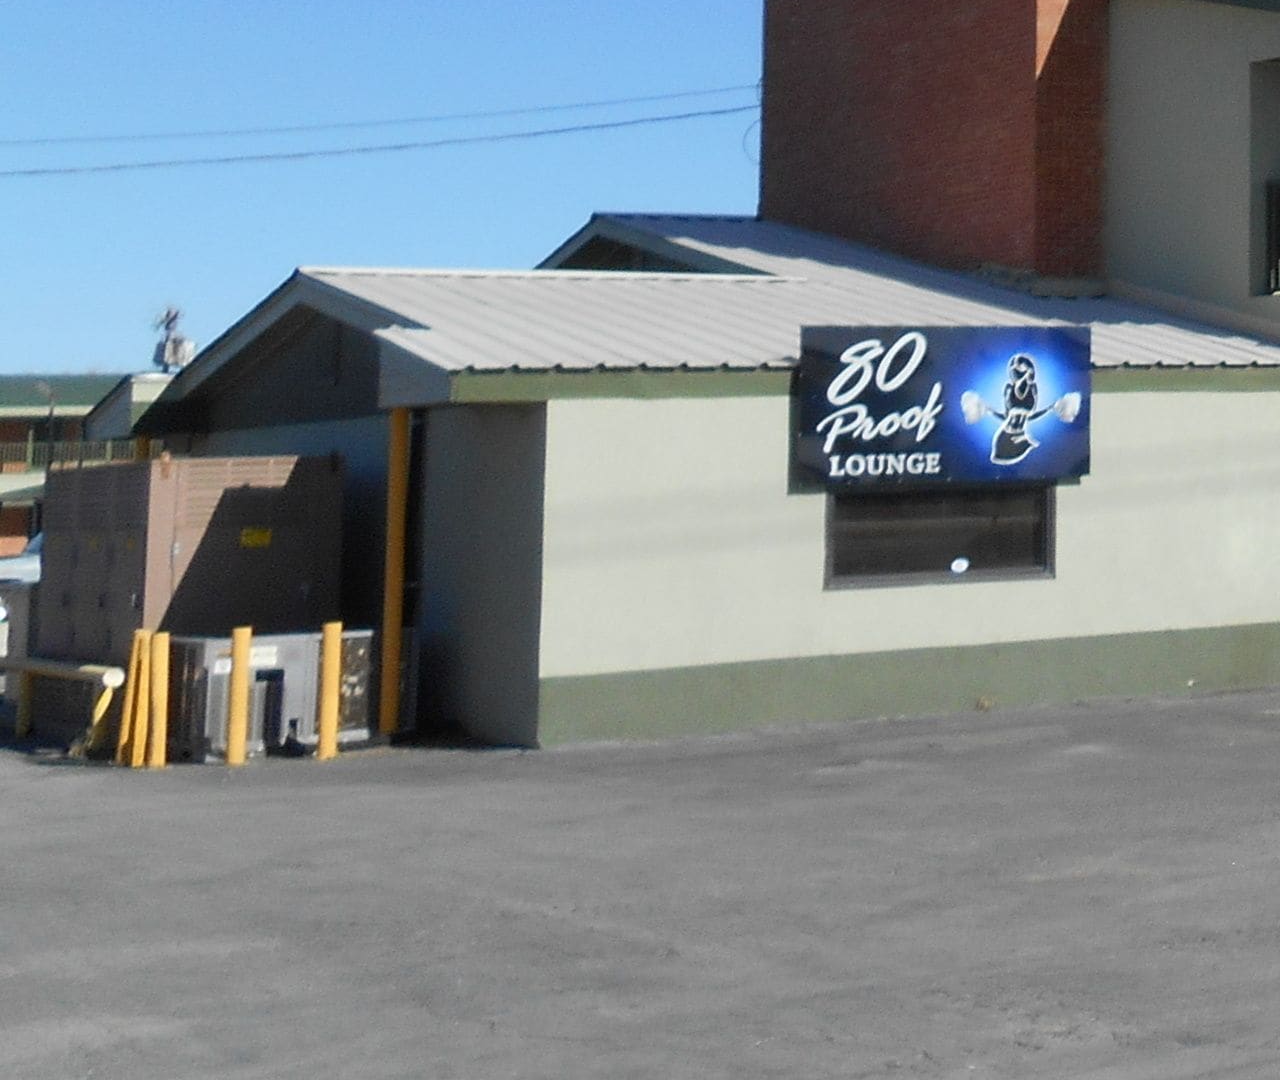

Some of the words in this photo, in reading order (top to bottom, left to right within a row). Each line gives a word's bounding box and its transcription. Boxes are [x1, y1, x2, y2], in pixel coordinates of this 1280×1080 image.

[827, 332, 927, 406] 80
[816, 382, 943, 454] Proof
[829, 453, 940, 477] LOUNGE
